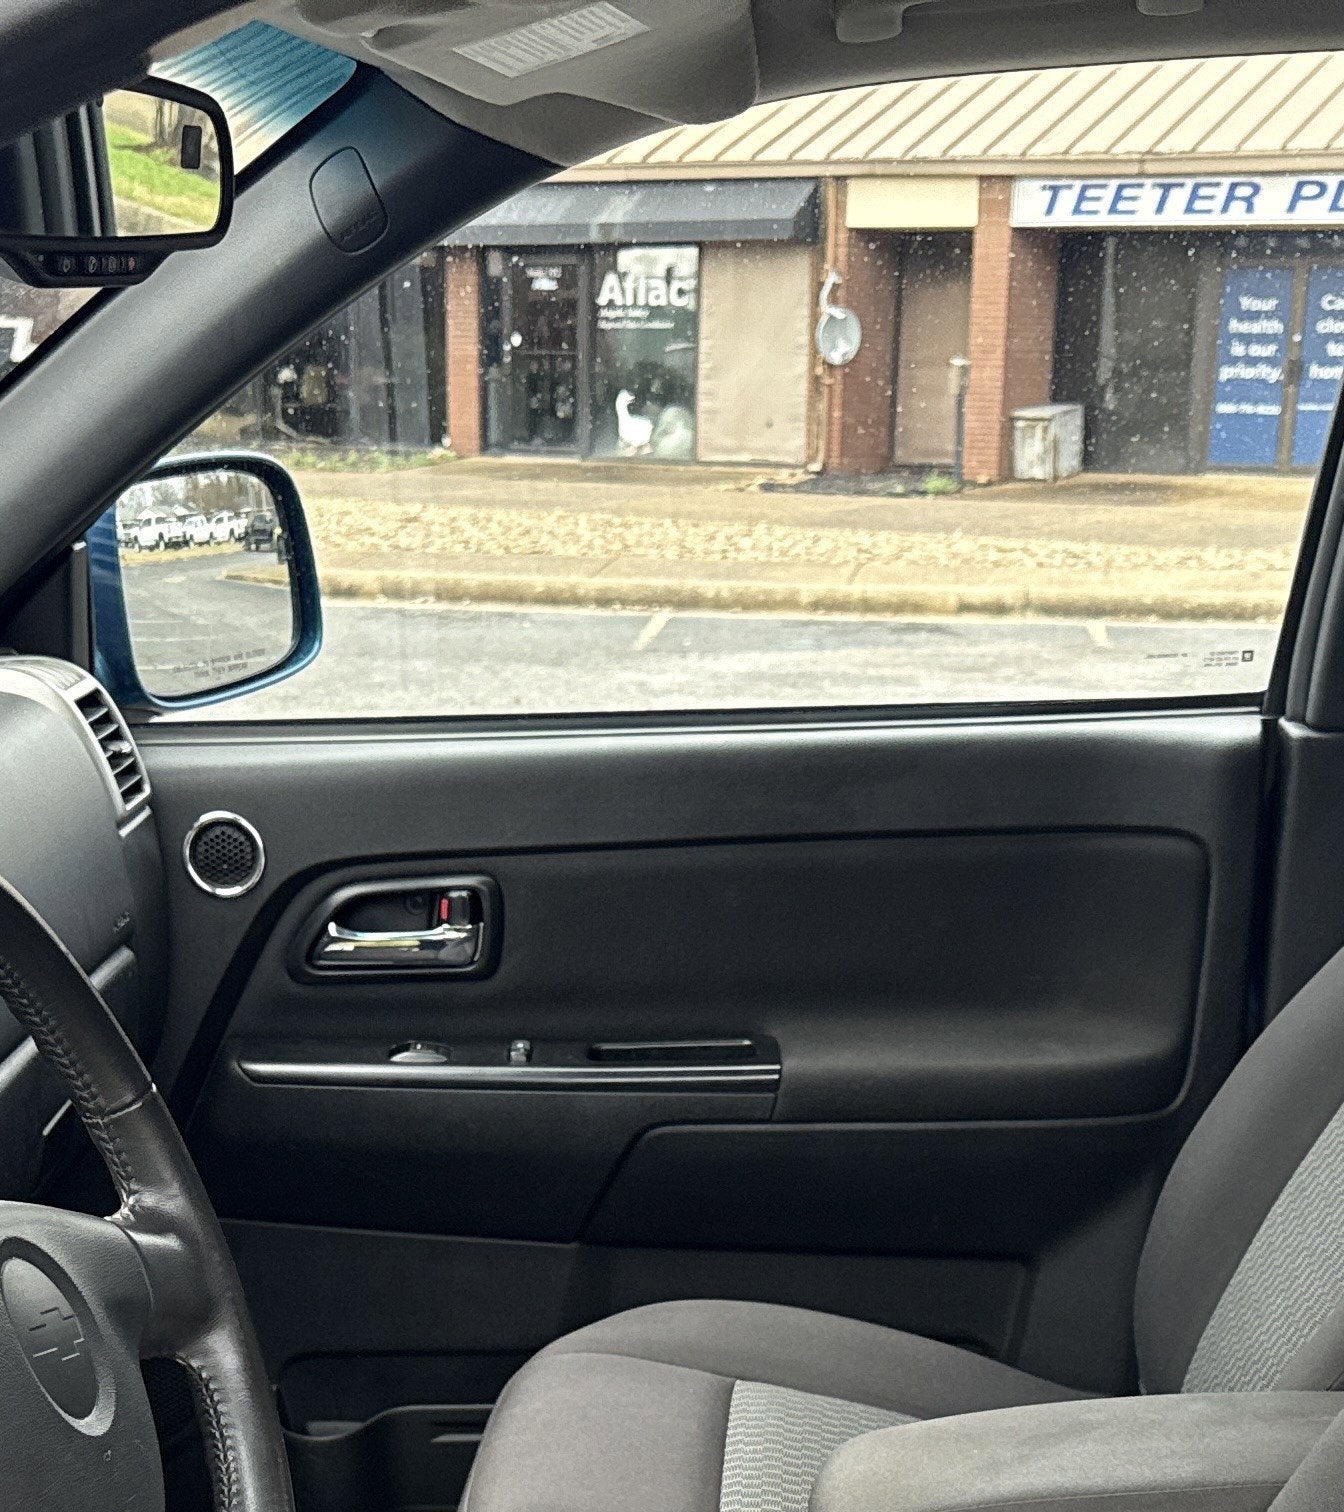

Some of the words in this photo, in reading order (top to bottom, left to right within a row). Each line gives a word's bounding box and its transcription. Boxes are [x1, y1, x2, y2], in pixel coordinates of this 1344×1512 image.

[1040, 180, 1262, 216] TEETER
[596, 271, 694, 307] Aflac
[1239, 293, 1278, 311] Your
[1228, 317, 1284, 334] health
[1229, 338, 1247, 357] is
[1247, 343, 1278, 357] our
